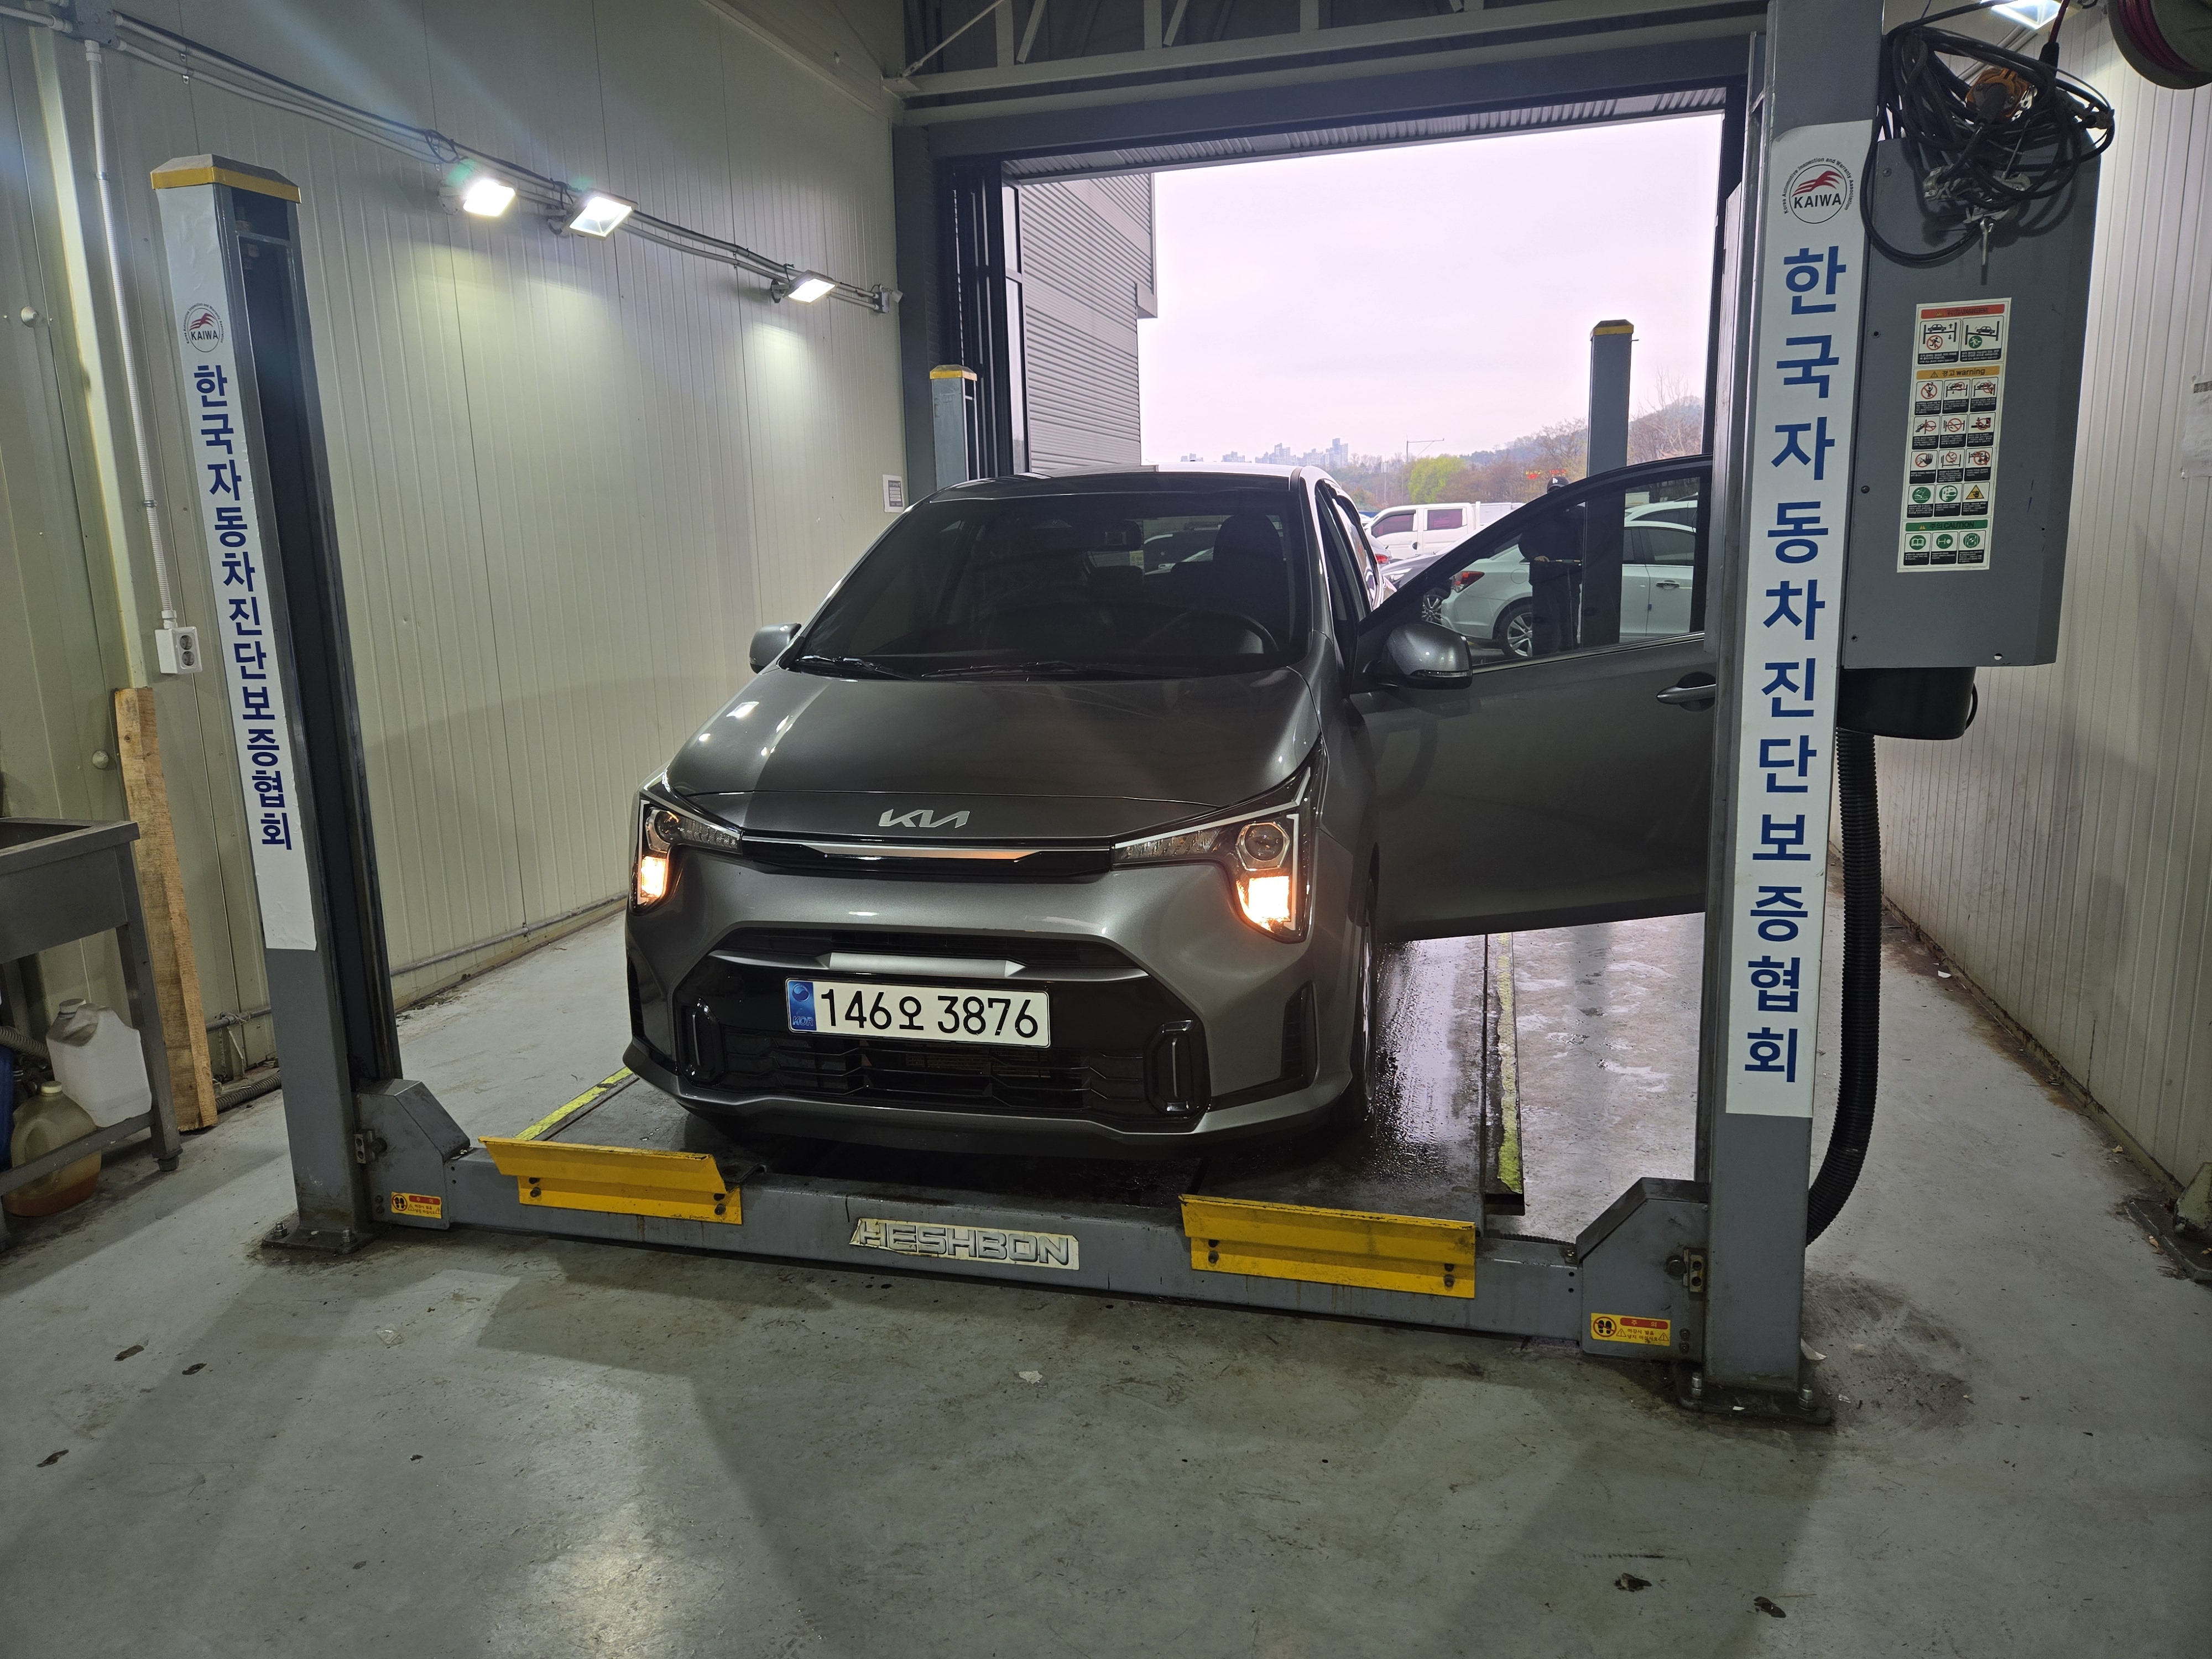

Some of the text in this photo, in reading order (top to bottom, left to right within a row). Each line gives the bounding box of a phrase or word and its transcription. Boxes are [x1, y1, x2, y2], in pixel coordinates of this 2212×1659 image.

[1836, 160, 1852, 179] Warranty
[1794, 193, 1841, 209] KAIWA
[191, 330, 218, 341] KAIWA
[194, 364, 292, 851] 한국자동차진단보증협회
[1744, 246, 1846, 1083] 한국자동차진단보증협회
[878, 808, 971, 828] KIA
[792, 1016, 813, 1026] KOR
[821, 988, 1039, 1039] 146오 3876
[859, 1219, 1070, 1266] HESHBON
